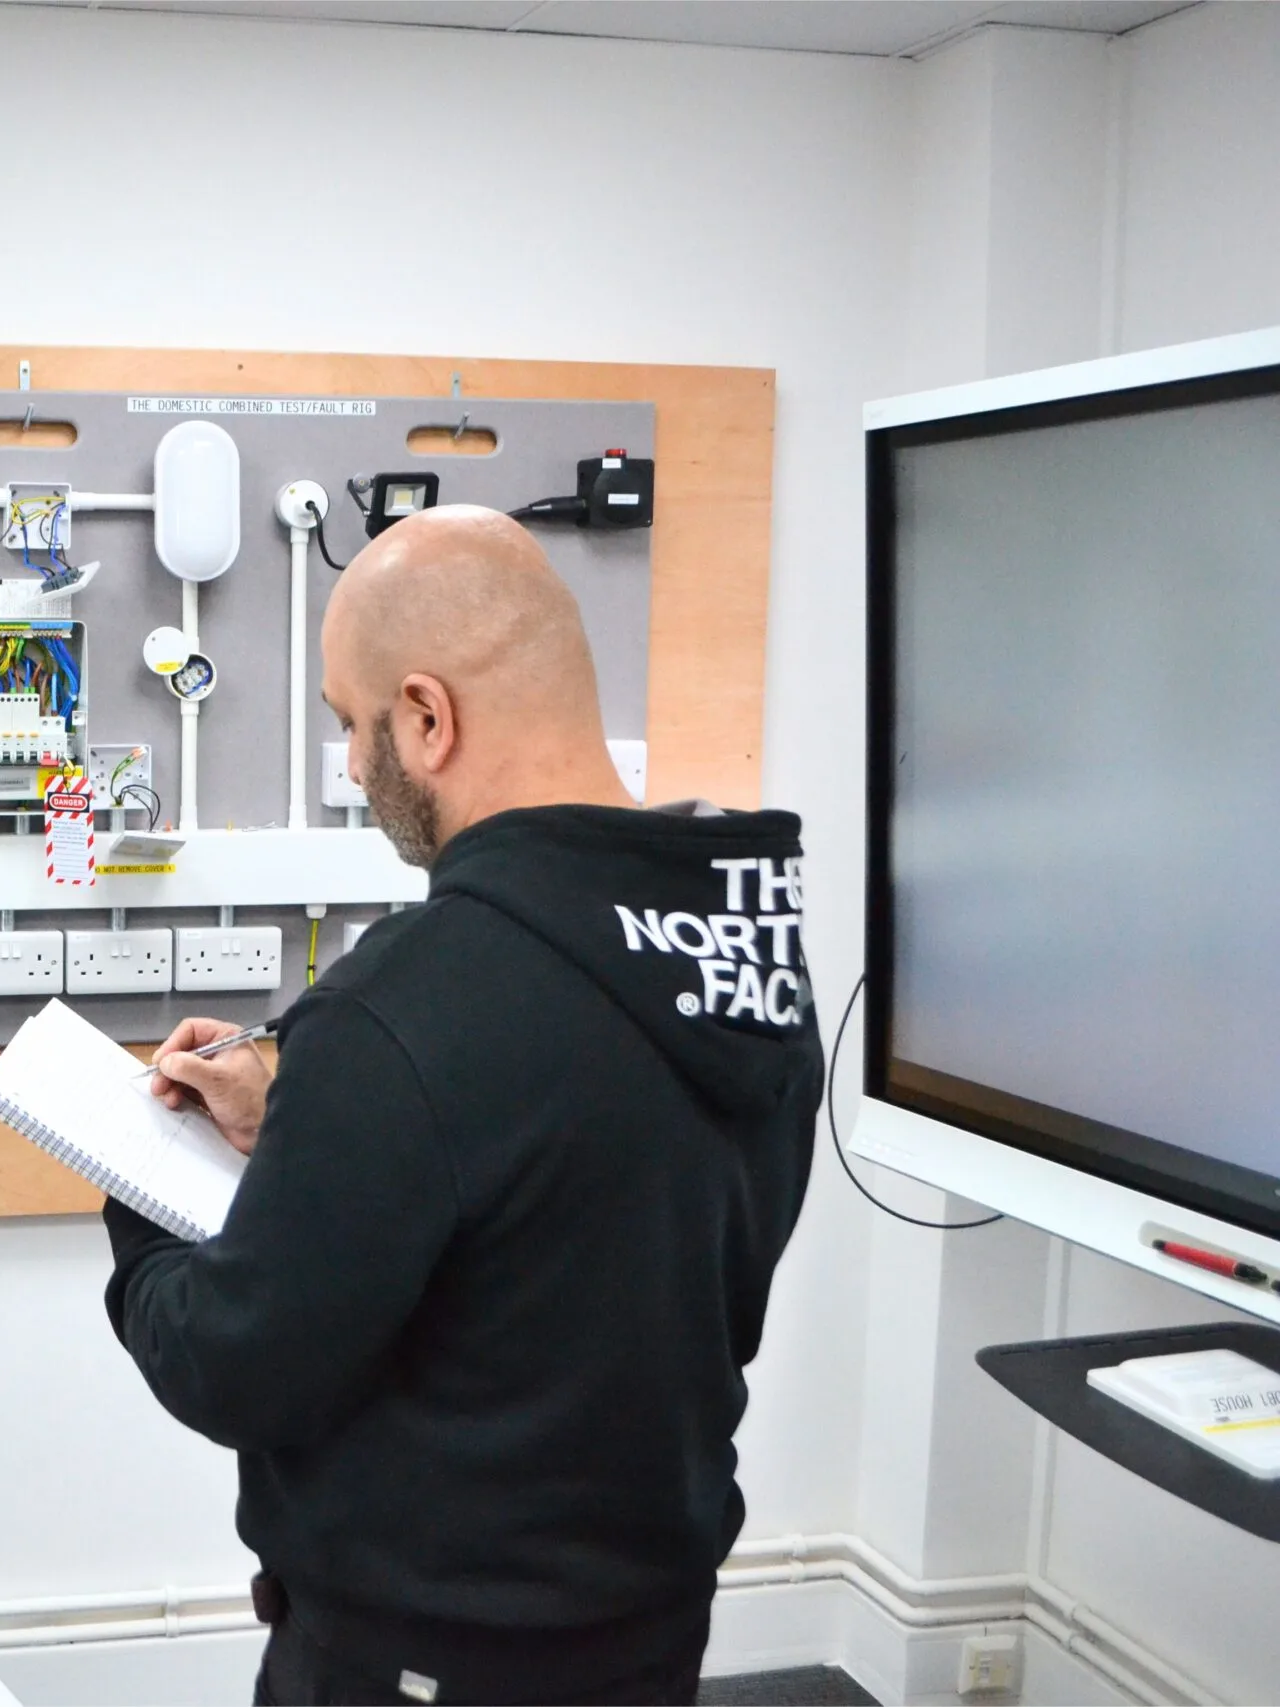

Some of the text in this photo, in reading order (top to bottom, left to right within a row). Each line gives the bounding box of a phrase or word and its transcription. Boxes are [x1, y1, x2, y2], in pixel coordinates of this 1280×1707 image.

[132, 399, 372, 414] THE DOMESTIC COMBINED TEST/FAULT RIG
[53, 798, 83, 806] DANGER
[614, 904, 803, 967] NORT
[697, 959, 801, 1026] FAC
[1210, 1392, 1253, 1413] HOUSE
